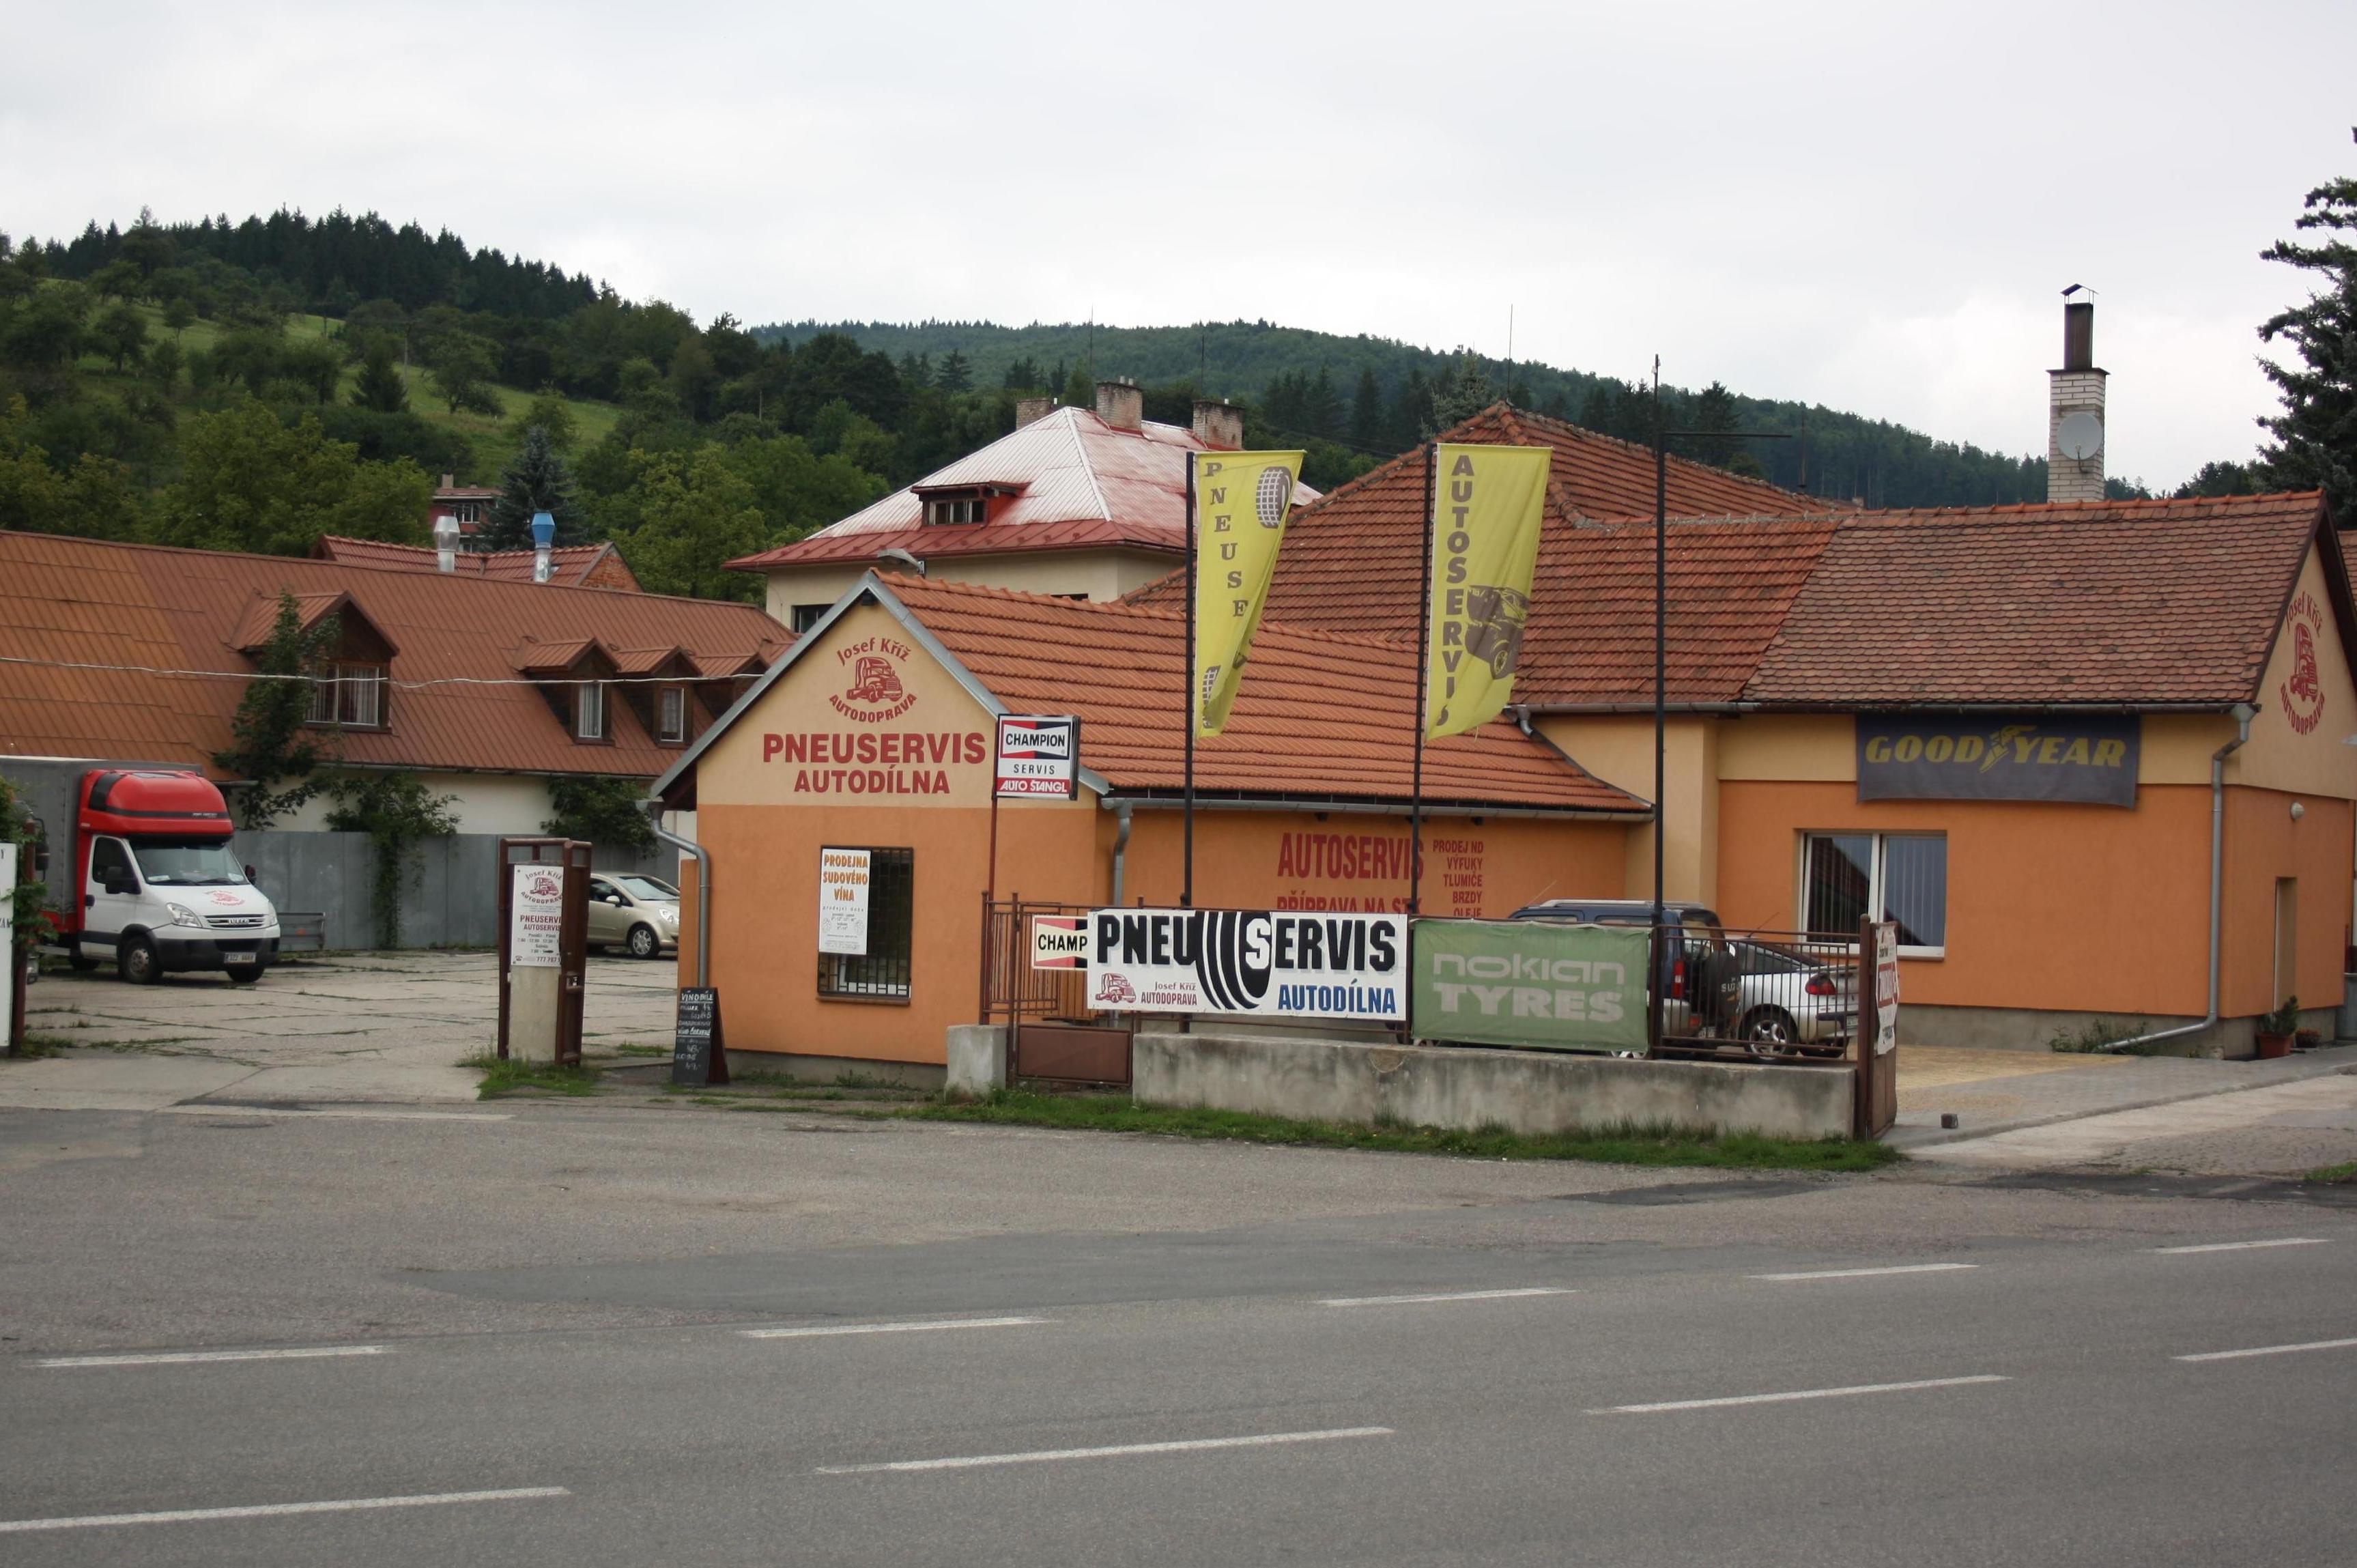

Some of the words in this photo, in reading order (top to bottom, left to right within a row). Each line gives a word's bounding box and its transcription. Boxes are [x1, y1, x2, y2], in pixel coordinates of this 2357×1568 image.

[2287, 590, 2306, 635] Josef
[836, 637, 876, 666] Josef
[881, 638, 911, 662] Kříž
[829, 693, 917, 723] AUTODOPRAVA
[2281, 683, 2325, 736] AUTODOPRAVA
[1005, 733, 1066, 747] CHAMPION
[763, 732, 986, 765] PNEUSERVIS
[1014, 764, 1055, 775] SERVIS
[794, 764, 950, 794] AUTODÍLNA
[1000, 780, 1028, 791] AUTO
[1030, 779, 1067, 793] ŠTANGL
[1433, 840, 1468, 853] PRODEJ
[1471, 840, 1484, 853] ND
[824, 854, 868, 868] PRODEJNA
[1277, 833, 1424, 880] AUTOSERVIS
[1447, 855, 1483, 870] VÝFUKY
[823, 870, 868, 885] SUDOVÉHO
[1443, 871, 1483, 887] TLUMIČE
[834, 886, 855, 902] VÍNA
[1453, 891, 1483, 904] BRZDY
[1453, 908, 1482, 917] OLEJE
[1038, 934, 1087, 952] CHAMP
[1155, 982, 1176, 991] Josef
[1180, 982, 1197, 991] Kříž
[1141, 991, 1197, 1006] AUTODOPRAVA
[1278, 978, 1397, 1014] AUTODÍLNA
[1433, 982, 1625, 1023] TYRES
